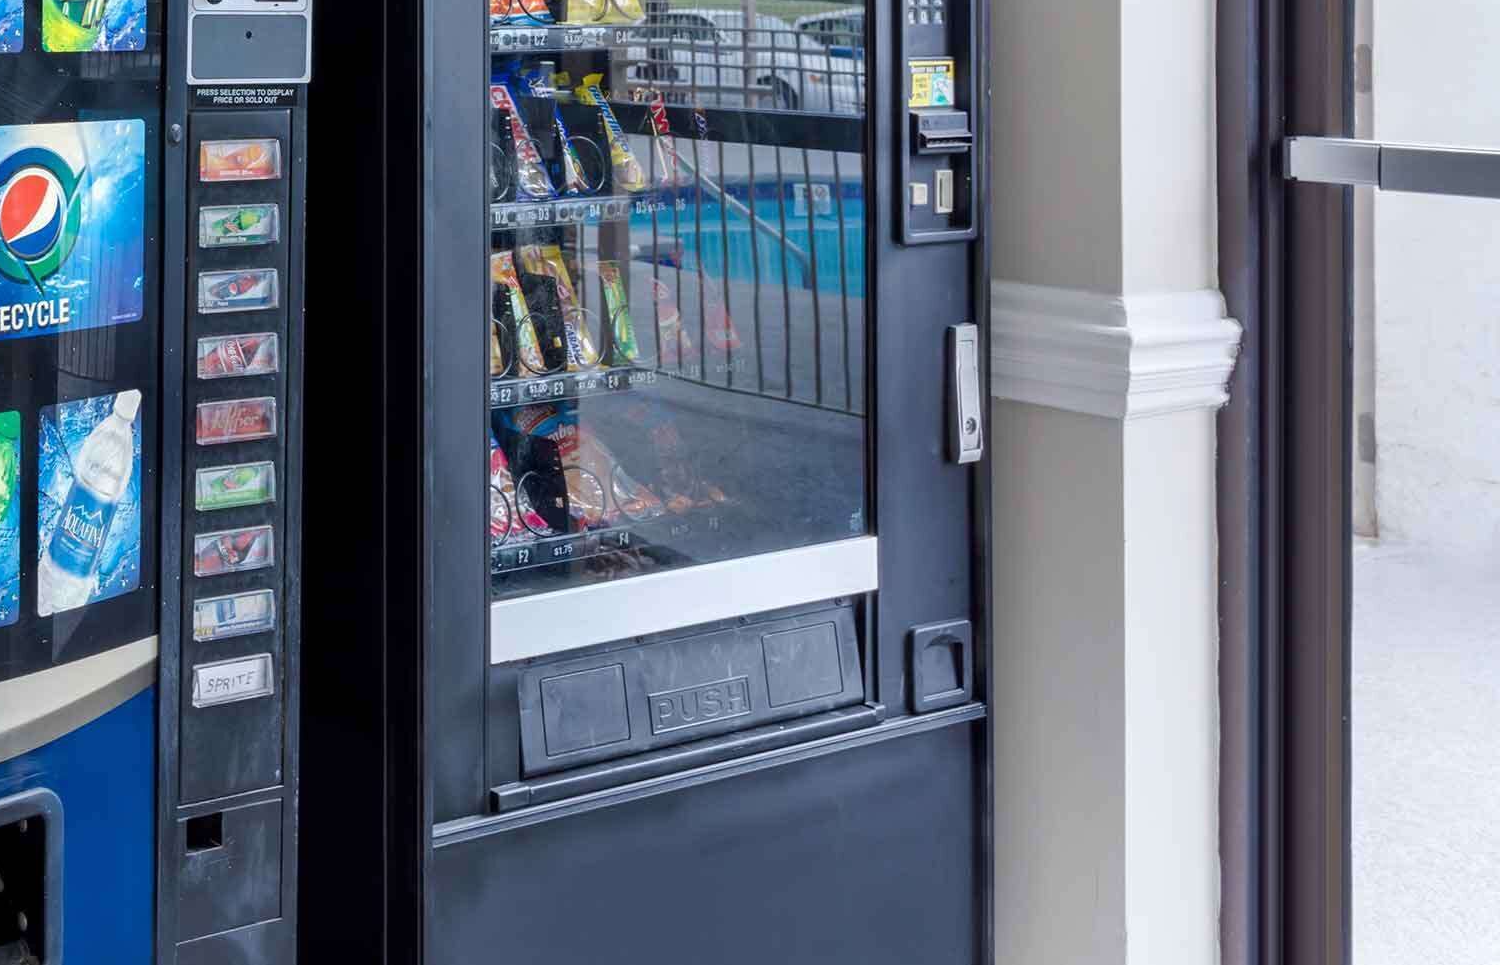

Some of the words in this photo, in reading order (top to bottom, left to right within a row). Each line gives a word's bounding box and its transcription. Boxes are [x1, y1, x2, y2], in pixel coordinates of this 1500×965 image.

[196, 88, 219, 96] PRESS
[219, 88, 256, 96] SELECTION
[61, 509, 105, 549] AQUAFINA
[518, 549, 529, 564] F2
[553, 544, 573, 557] $1.75
[204, 669, 257, 693] SPRITE
[657, 679, 750, 731] PUSH
